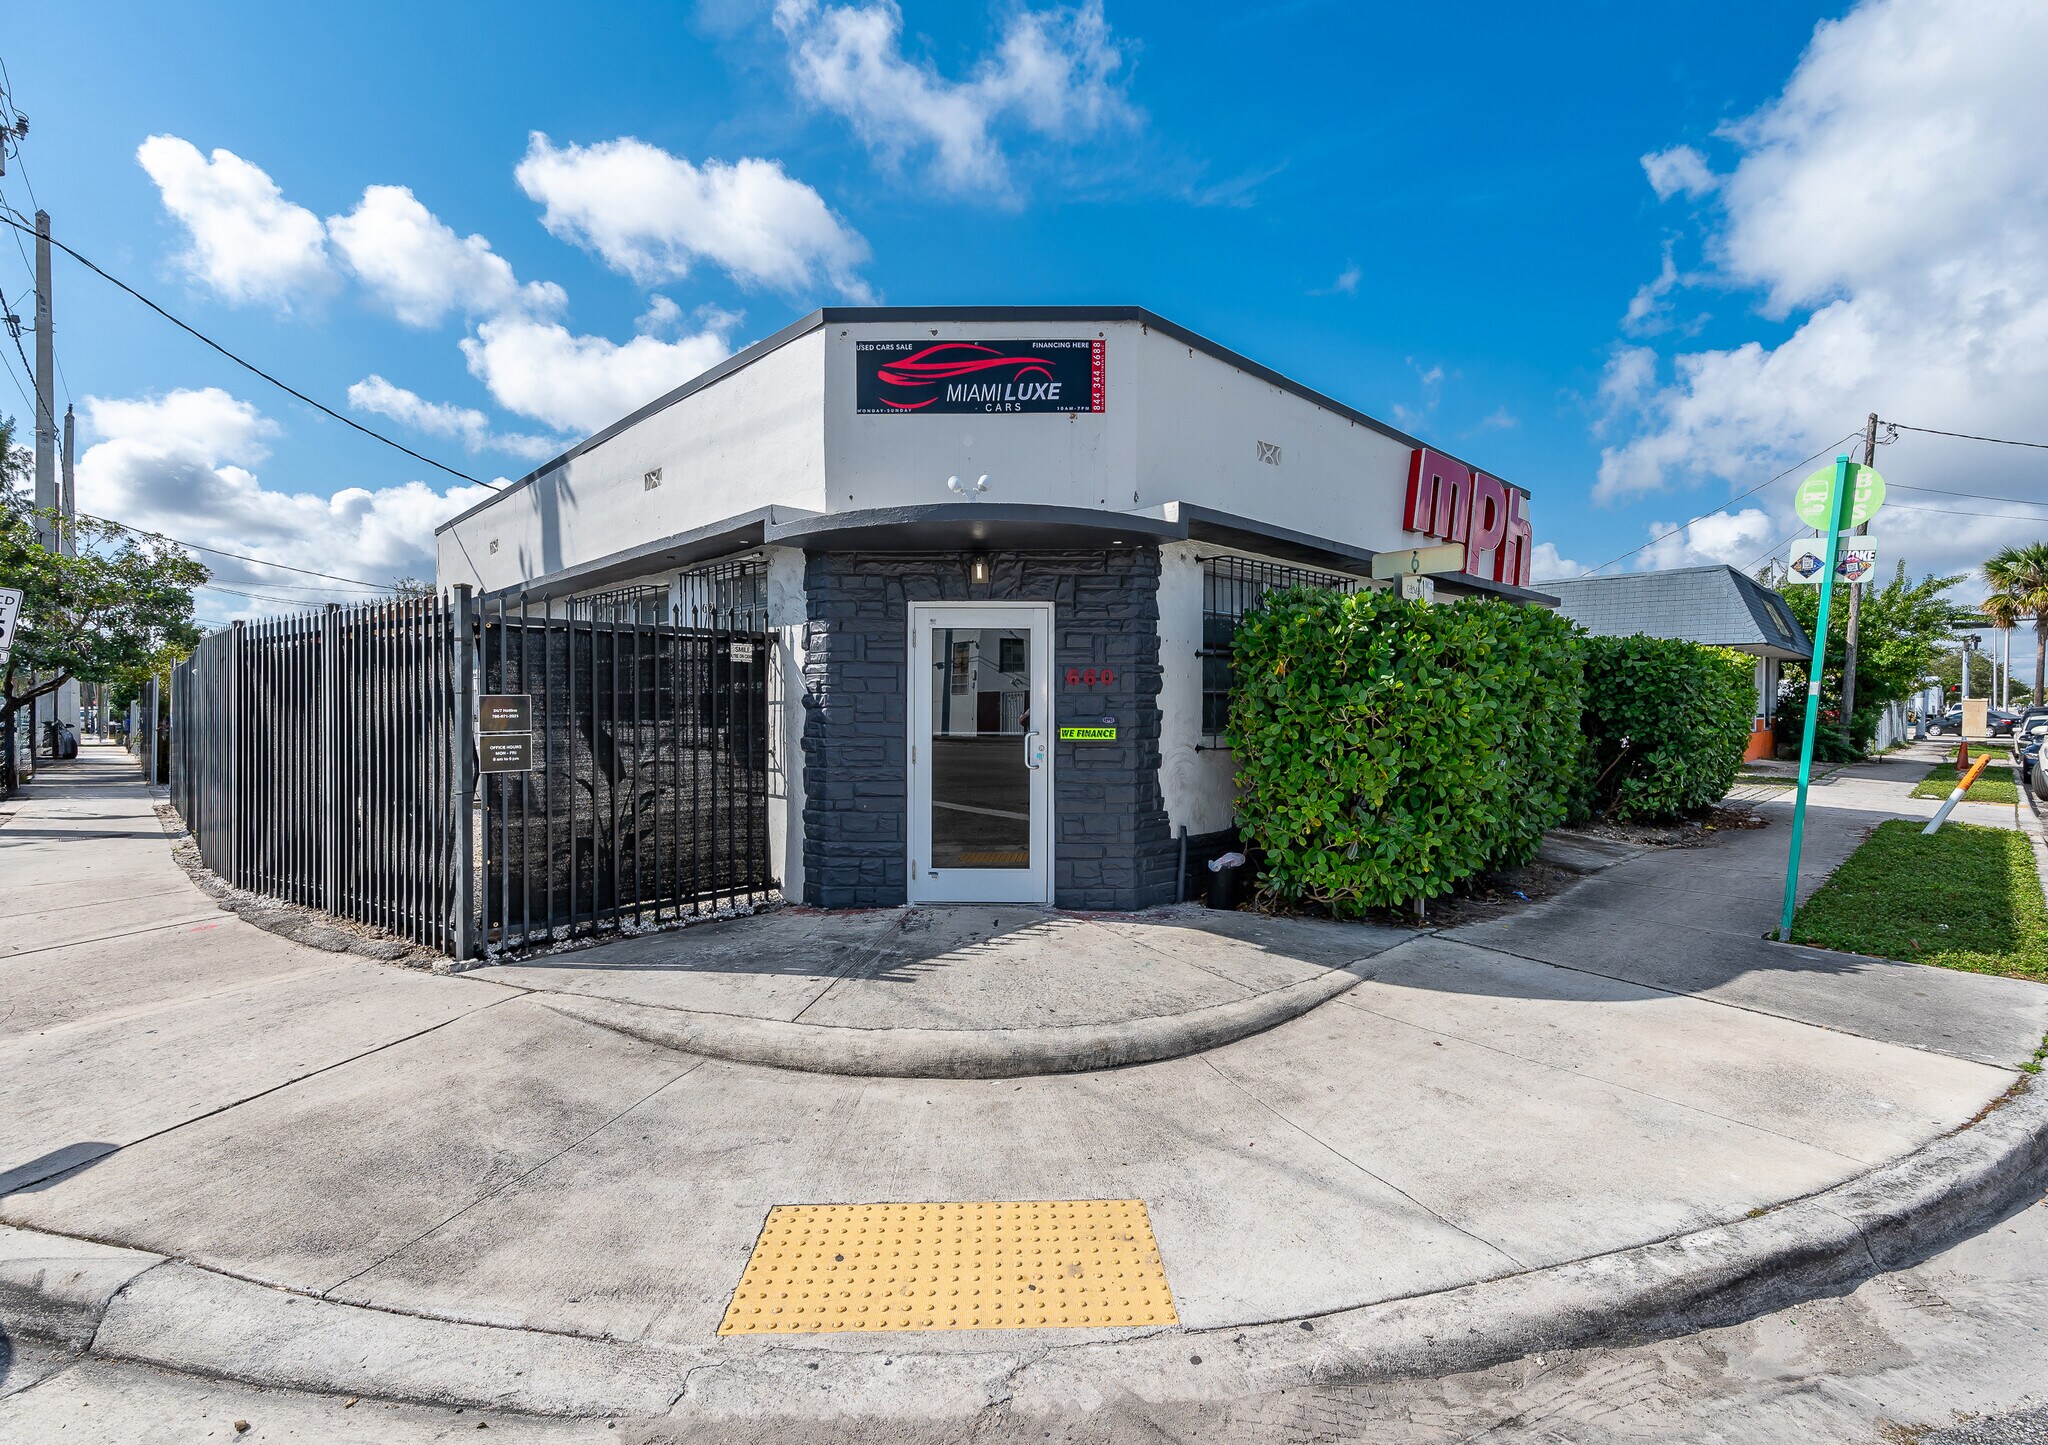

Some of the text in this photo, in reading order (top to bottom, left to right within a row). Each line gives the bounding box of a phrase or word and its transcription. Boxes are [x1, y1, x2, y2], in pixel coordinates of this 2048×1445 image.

[856, 343, 913, 352] USED CARS SALE
[1072, 341, 1090, 349] HERE
[1093, 342, 1101, 411] 844 344 6688
[946, 382, 1063, 402] MIAMI LUXE
[985, 403, 1022, 412] CARS
[1852, 472, 1873, 520] BUS
[1065, 668, 1115, 686] 660
[1061, 729, 1115, 738] WE FINANCE
